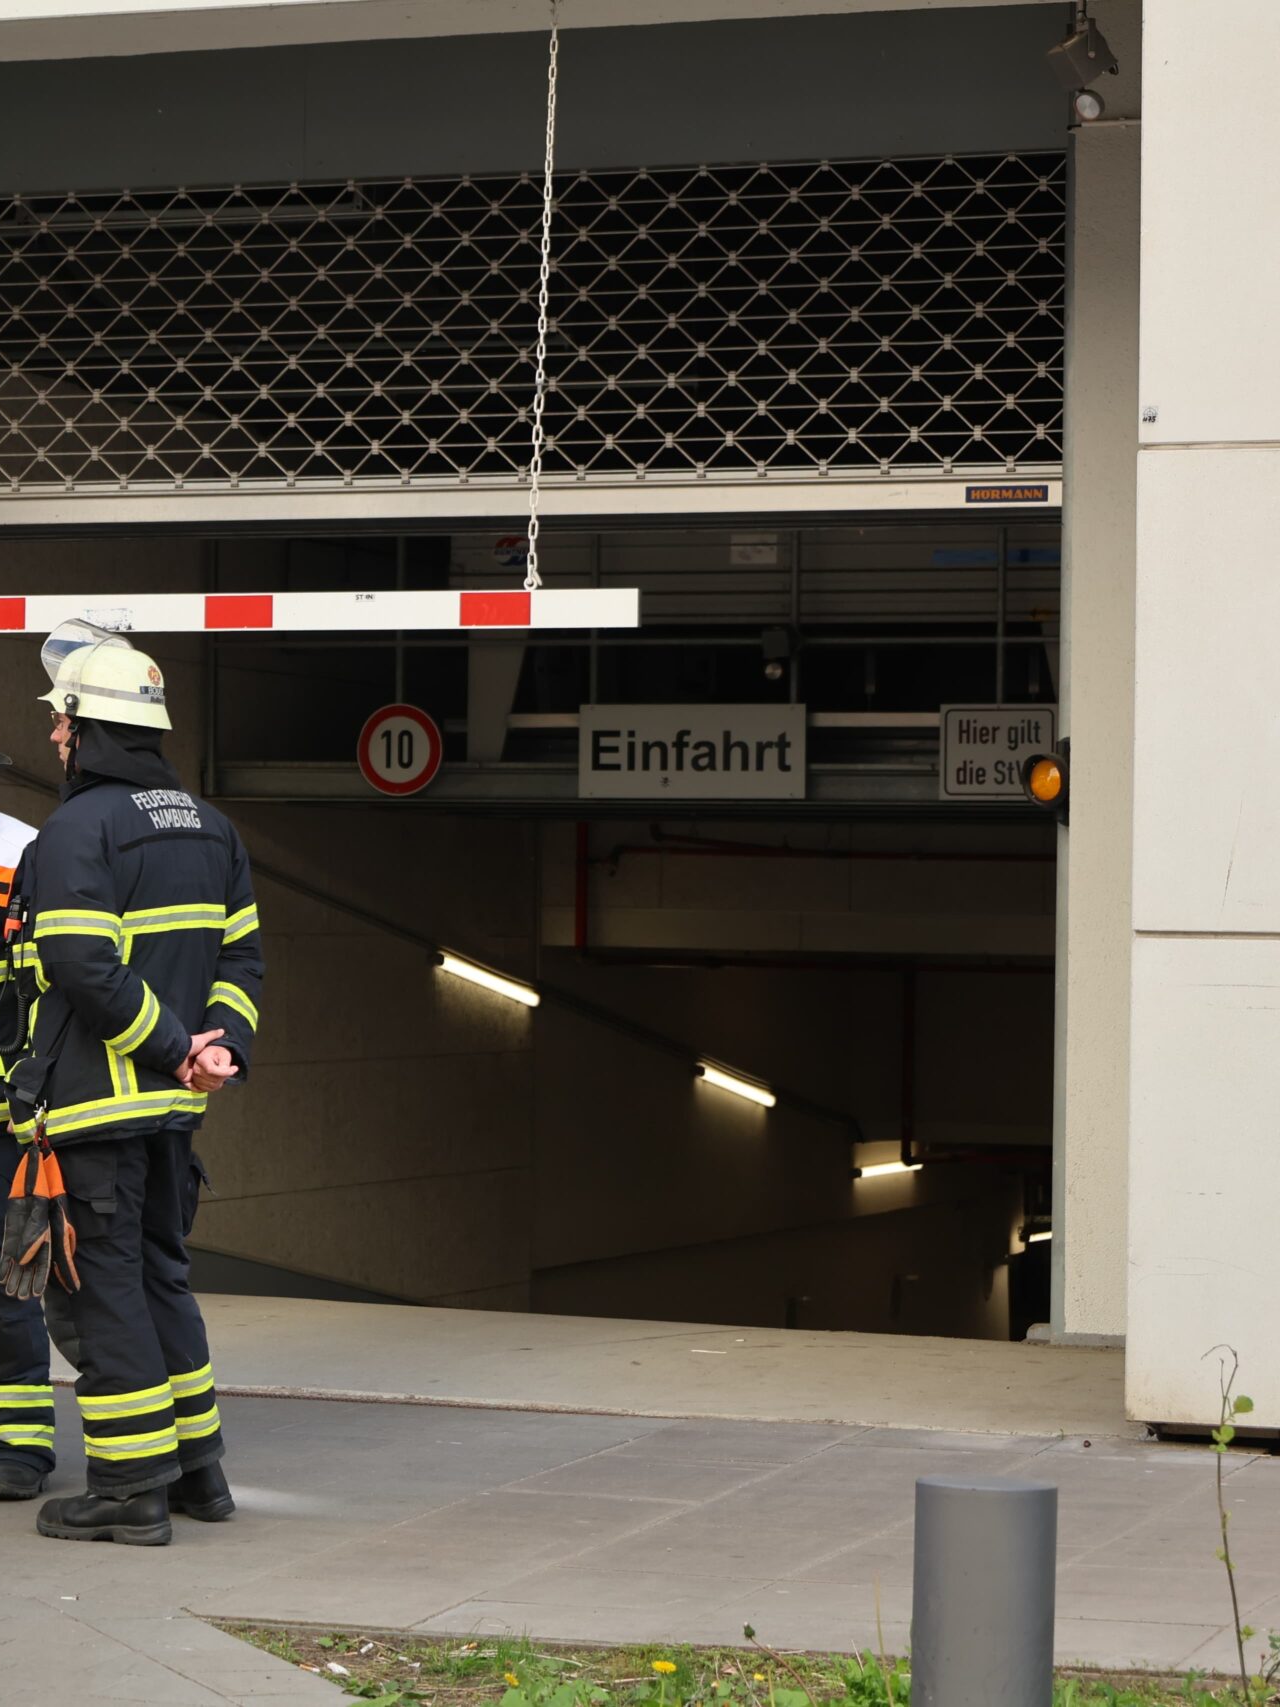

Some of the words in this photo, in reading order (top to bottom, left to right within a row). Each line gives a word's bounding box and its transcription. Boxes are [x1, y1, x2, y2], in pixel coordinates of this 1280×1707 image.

[380, 730, 413, 769] 10
[959, 720, 1000, 744] Hier
[1007, 719, 1042, 751] gilt
[591, 730, 791, 772] Einfahrt
[956, 759, 986, 785] die
[131, 789, 198, 810] FEUERWEHR
[149, 809, 202, 830] HAMBURG
